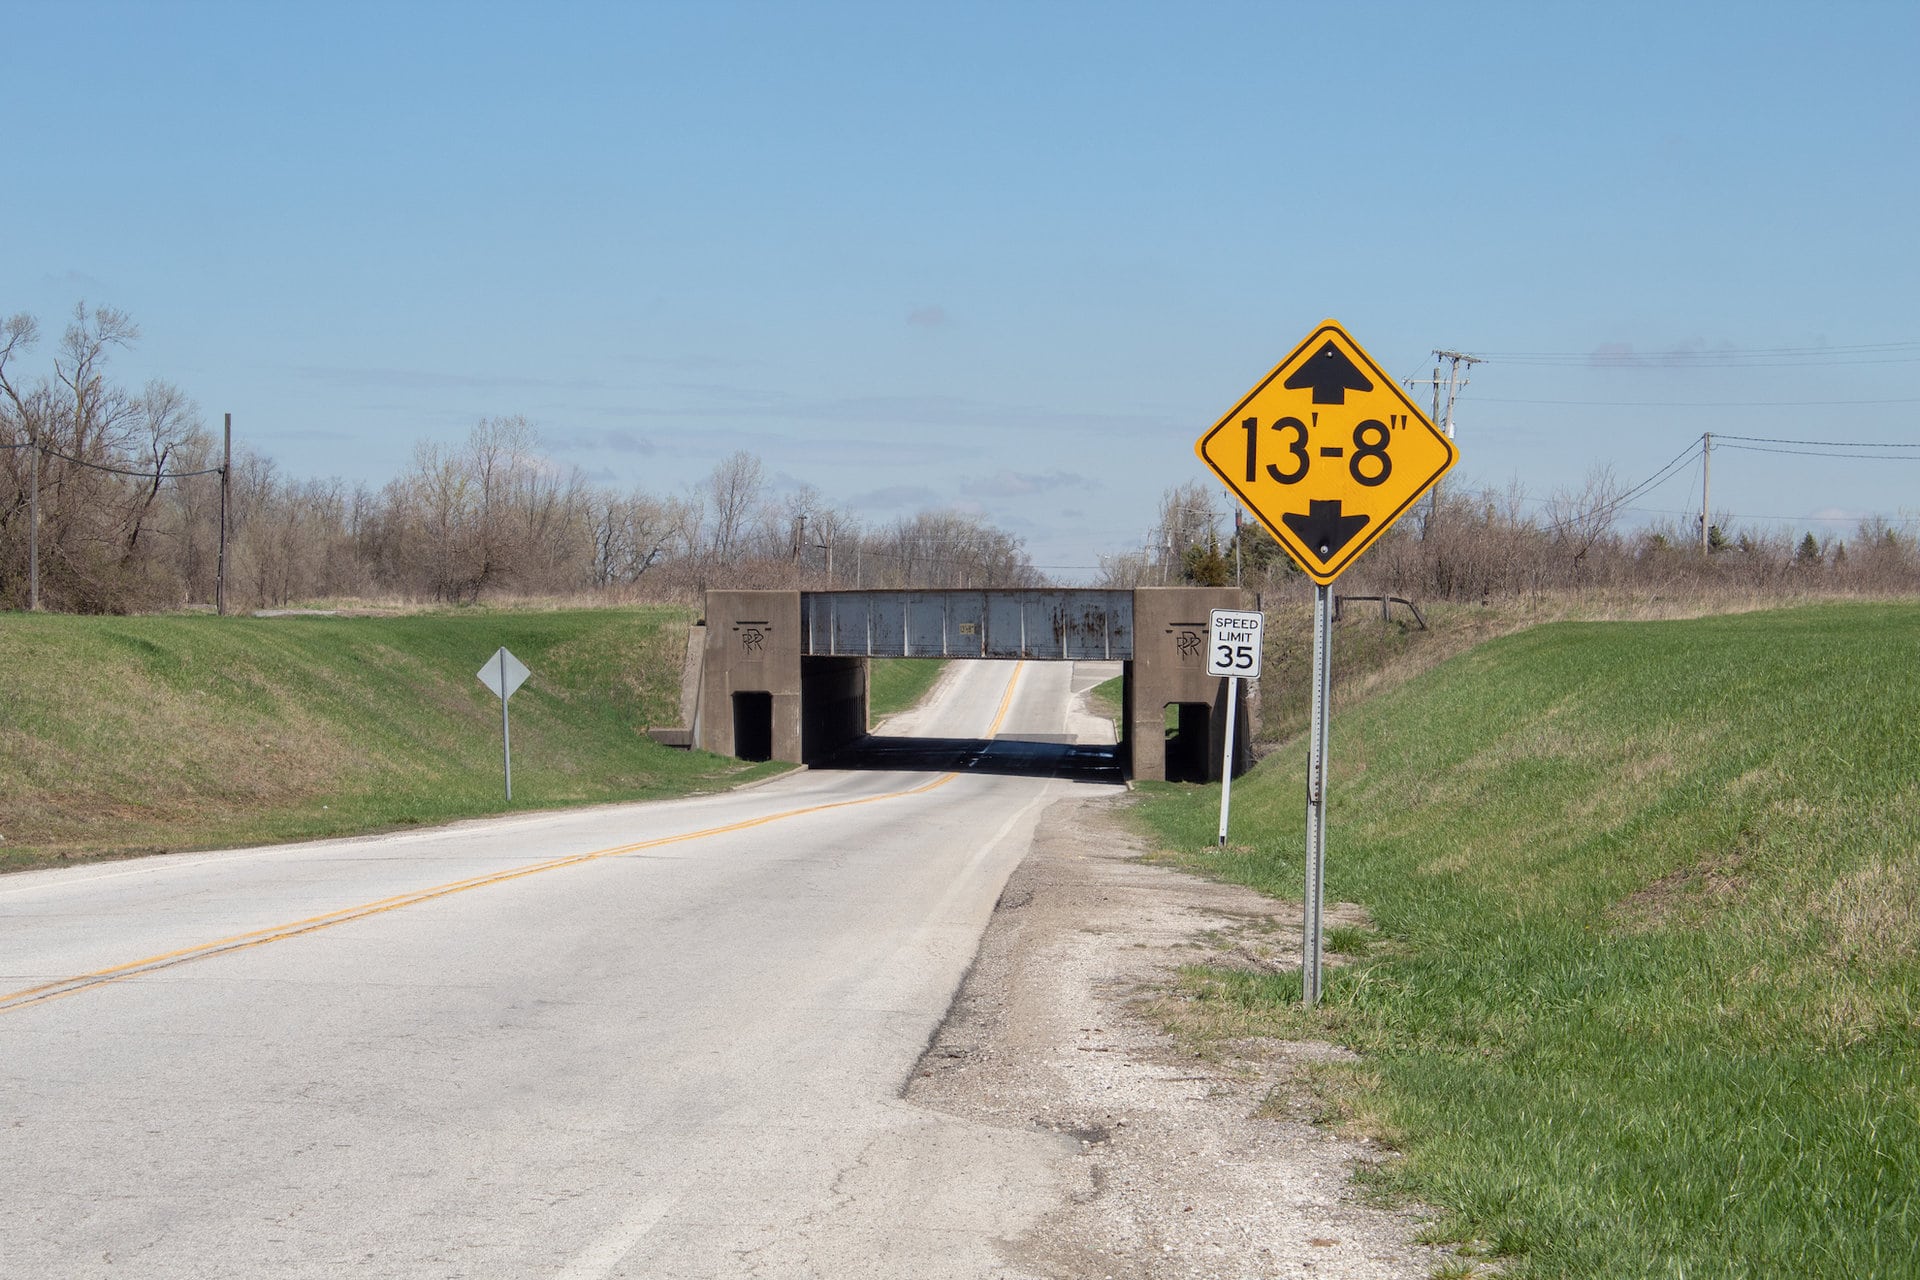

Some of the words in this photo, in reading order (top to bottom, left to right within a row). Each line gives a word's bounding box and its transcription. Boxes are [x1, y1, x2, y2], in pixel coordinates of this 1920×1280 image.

[1241, 412, 1408, 487] 13'-8"
[1215, 617, 1259, 630] SPEED
[1219, 631, 1253, 643] LIMIT
[1215, 645, 1253, 669] 35
